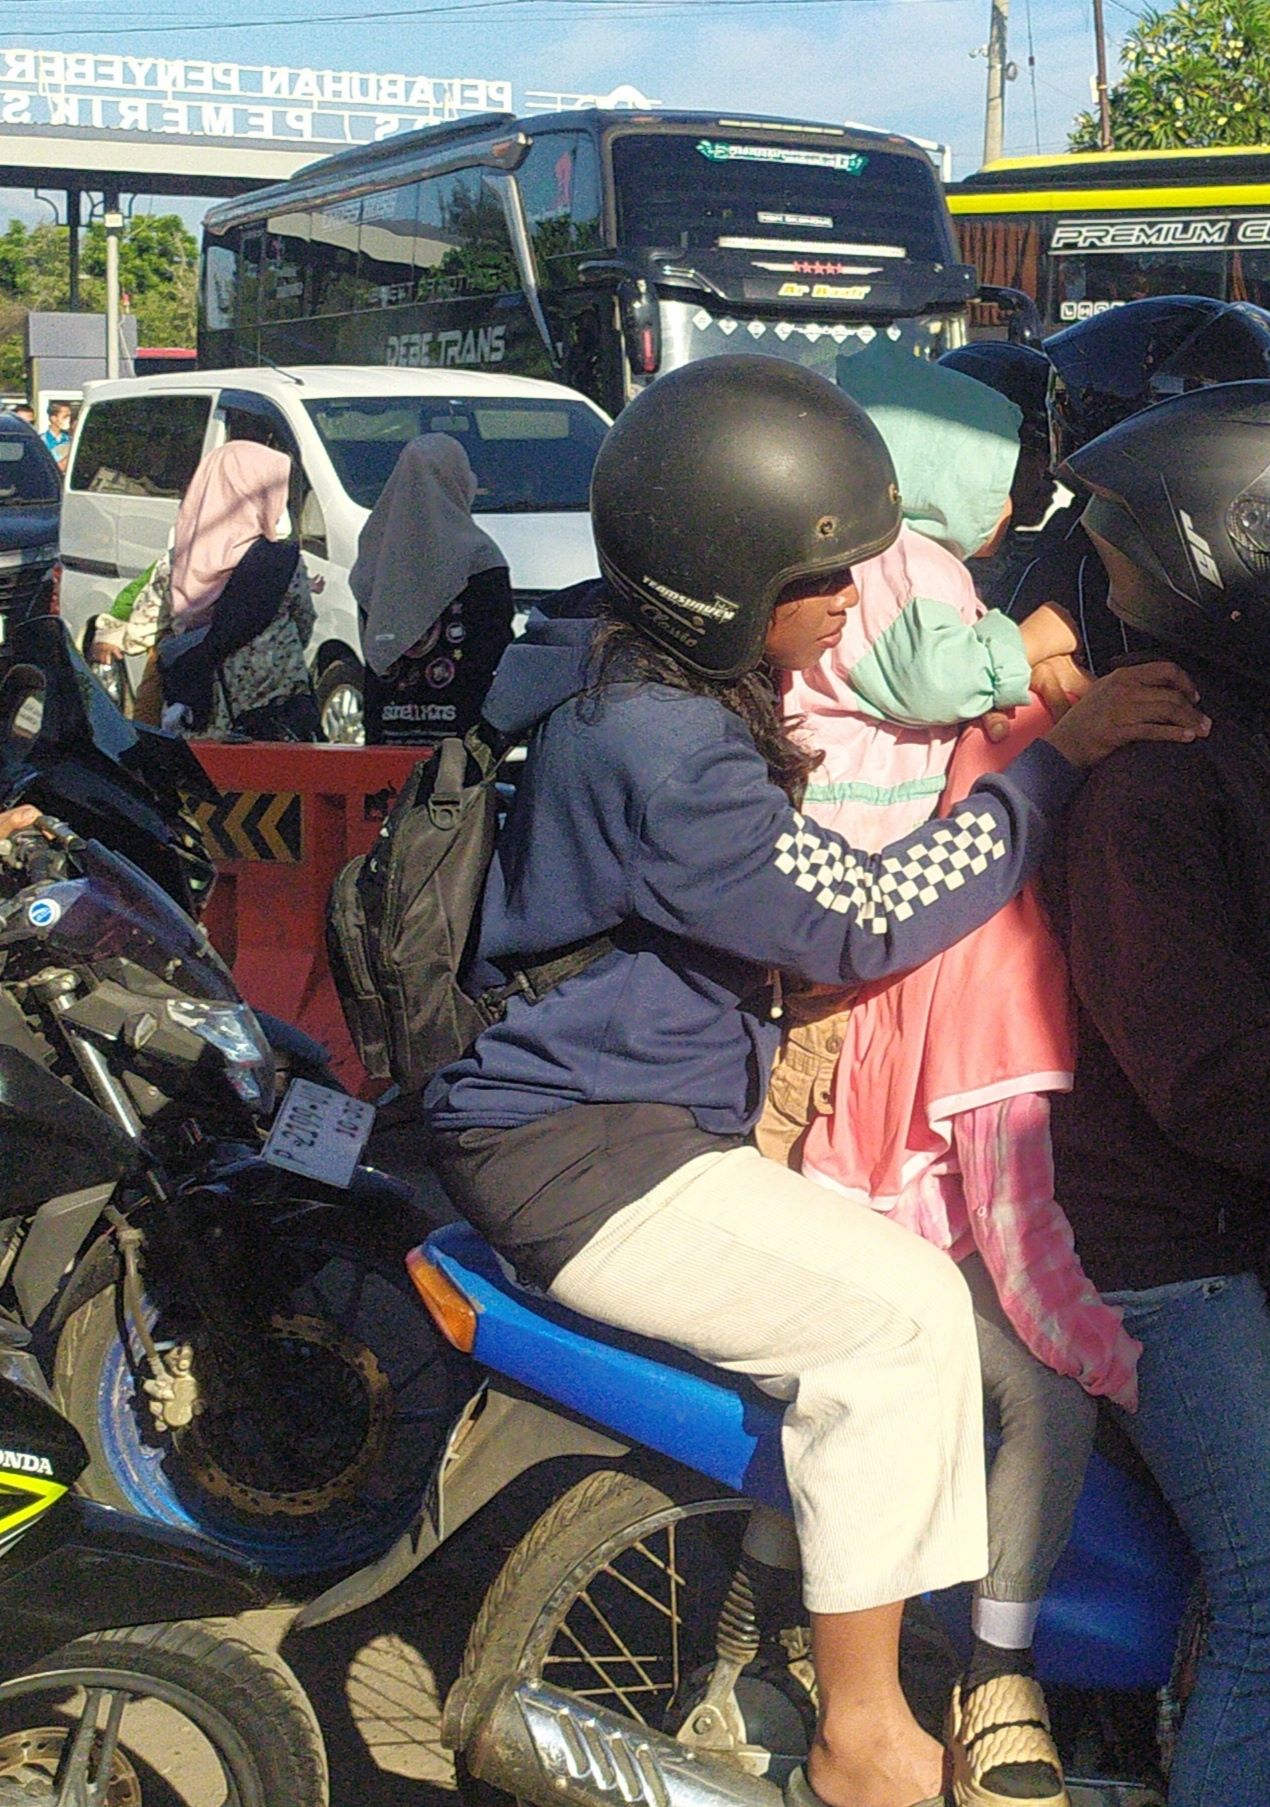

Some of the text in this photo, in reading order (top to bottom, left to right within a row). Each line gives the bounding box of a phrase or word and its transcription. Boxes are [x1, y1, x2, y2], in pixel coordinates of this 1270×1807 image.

[1050, 222, 1231, 248] PREMIUM
[437, 325, 506, 366] TRANS
[281, 1105, 323, 1148] 2199
[0, 1449, 54, 1476] NDA
